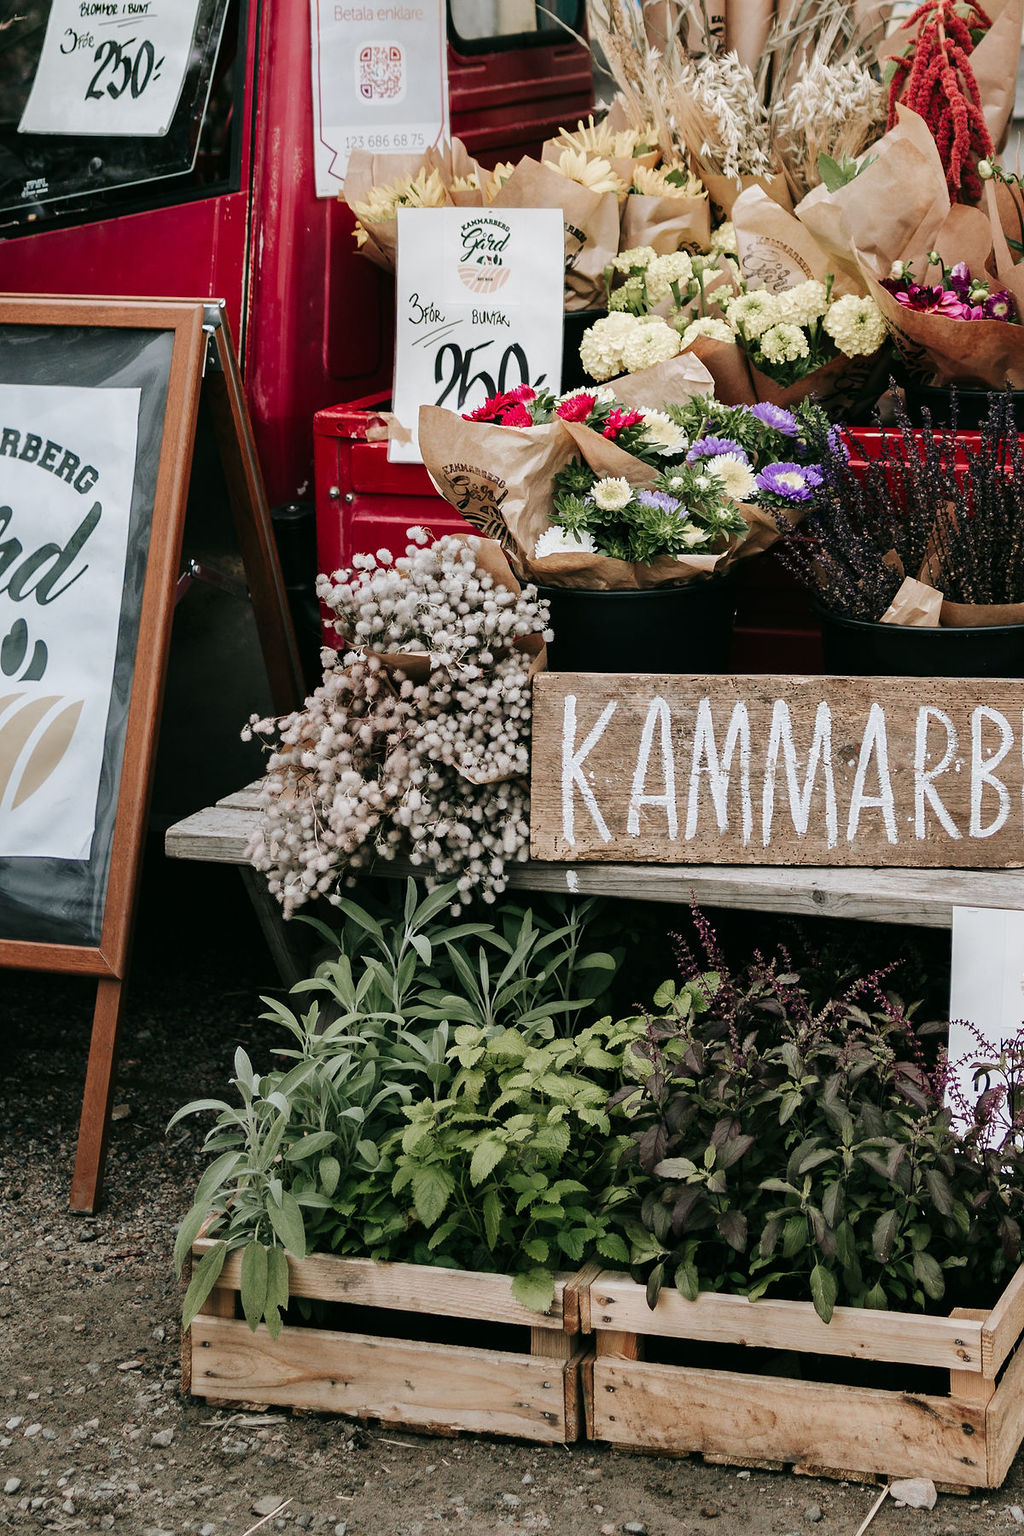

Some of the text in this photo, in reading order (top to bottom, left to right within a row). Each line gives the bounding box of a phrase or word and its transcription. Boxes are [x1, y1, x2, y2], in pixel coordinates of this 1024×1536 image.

[79, 2, 118, 17] BLOMMOR
[128, 2, 152, 14] BUNT
[334, 5, 424, 21] Betala enklare
[60, 28, 78, 54] 3
[345, 133, 425, 149] 123 686 68 75
[461, 218, 511, 233] KAMMARBERG
[460, 227, 511, 263] Gård
[408, 293, 424, 325] 3
